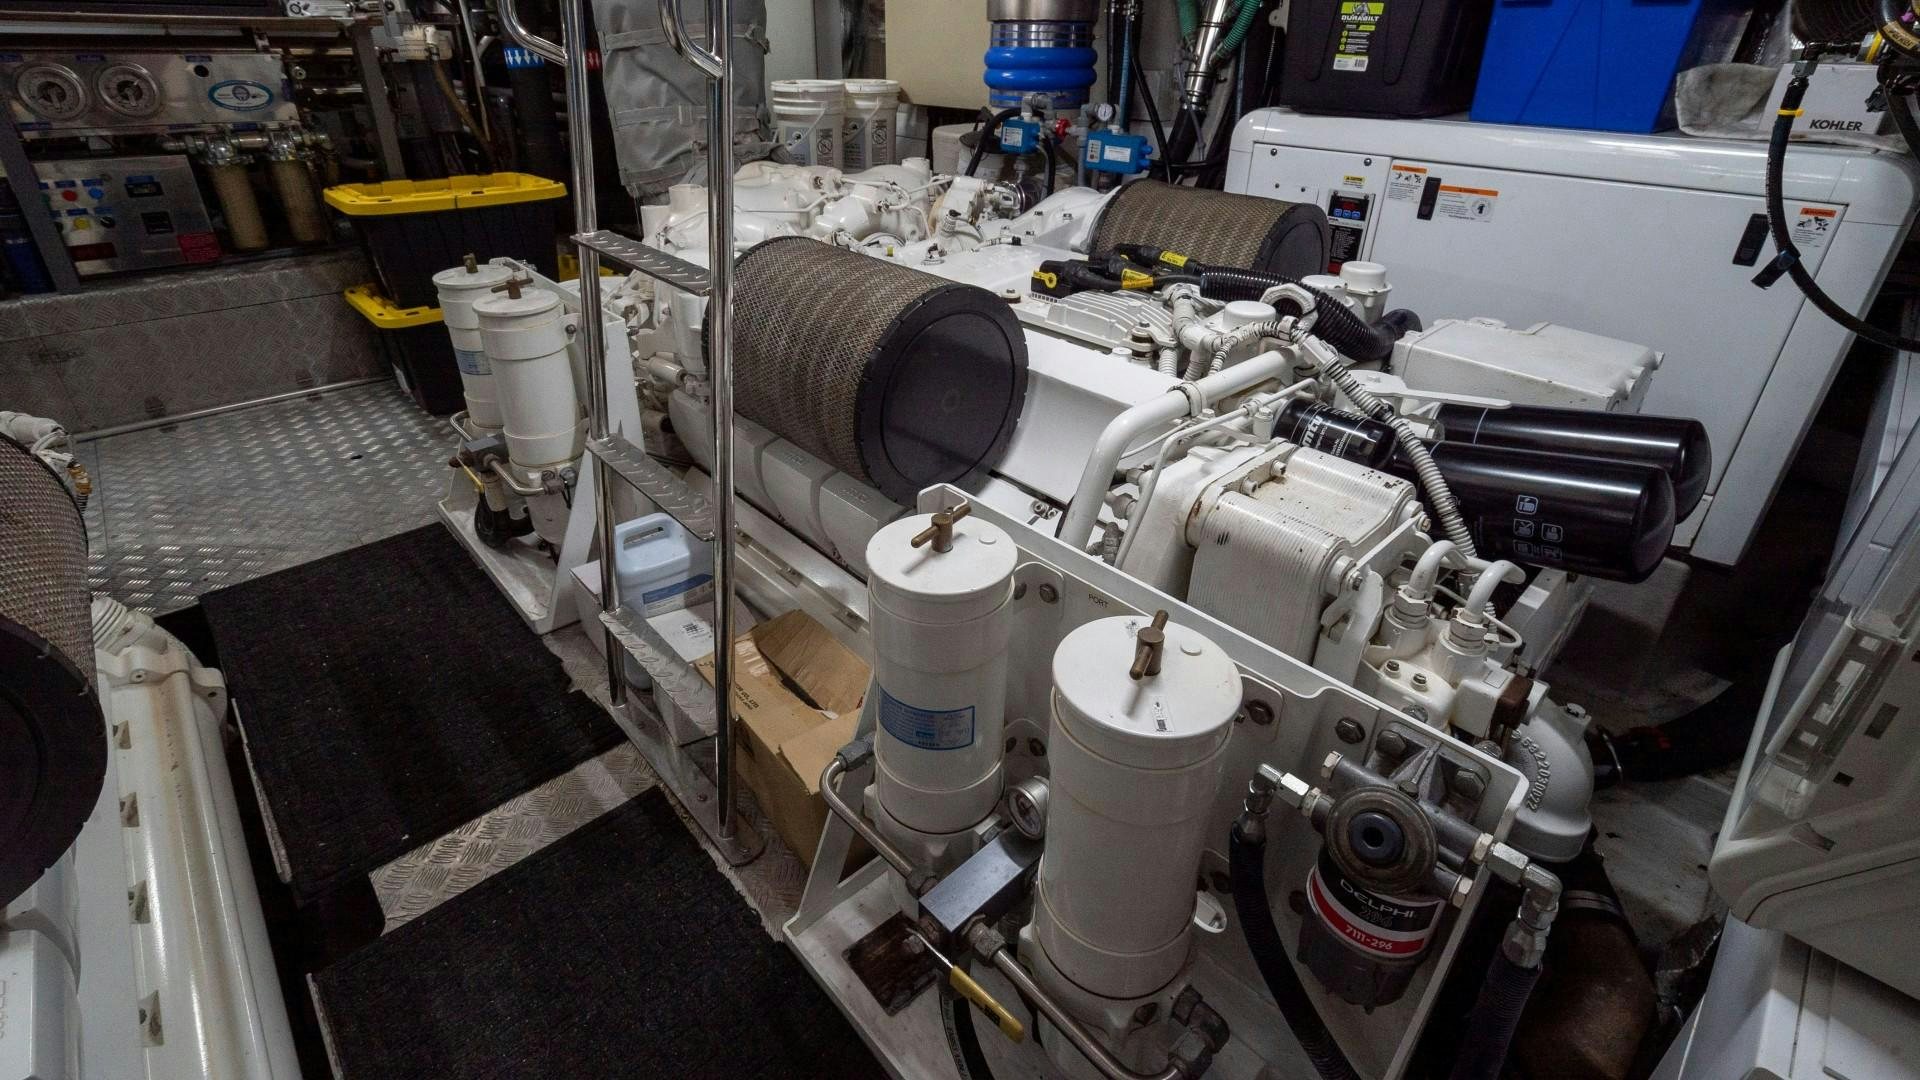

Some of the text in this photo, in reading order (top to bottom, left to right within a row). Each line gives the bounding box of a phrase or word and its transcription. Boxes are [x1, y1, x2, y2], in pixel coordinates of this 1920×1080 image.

[1809, 119, 1863, 132] KOHLER
[1301, 414, 1324, 448] mtu
[1088, 593, 1108, 608] PORT
[1340, 878, 1415, 918] DELPHI
[1345, 924, 1393, 951] 7111-296
